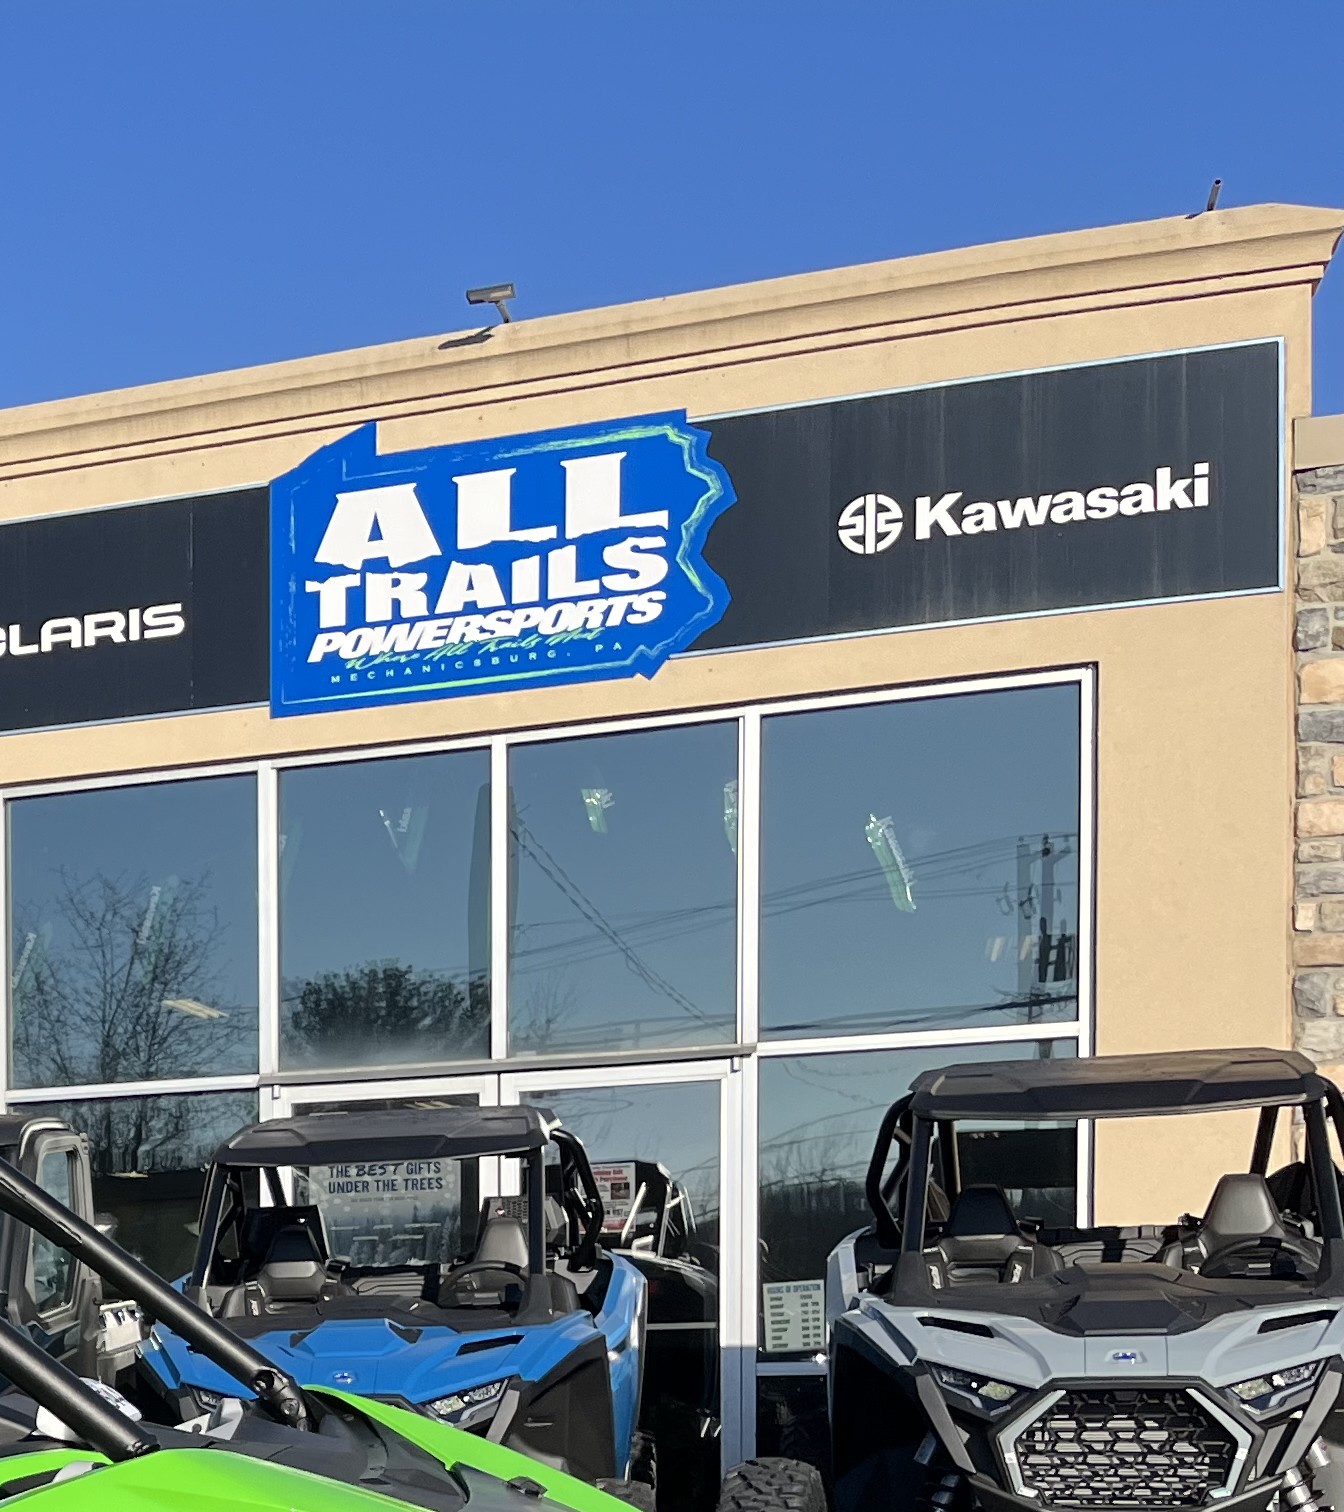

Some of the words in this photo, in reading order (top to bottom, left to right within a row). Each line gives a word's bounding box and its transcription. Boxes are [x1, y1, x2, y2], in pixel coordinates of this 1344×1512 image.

[314, 452, 668, 570] ALL
[915, 462, 1209, 540] Kawasaki
[305, 536, 669, 628] TRAILS
[307, 591, 667, 663] POWERSPORTS
[595, 642, 623, 653] PA
[328, 1180, 369, 1194] UNDER
[372, 1179, 398, 1192] THE
[403, 1177, 443, 1191] TREES
[329, 1165, 350, 1178] THE
[355, 1163, 403, 1177] BEST
[406, 1162, 441, 1175] GIFTS
